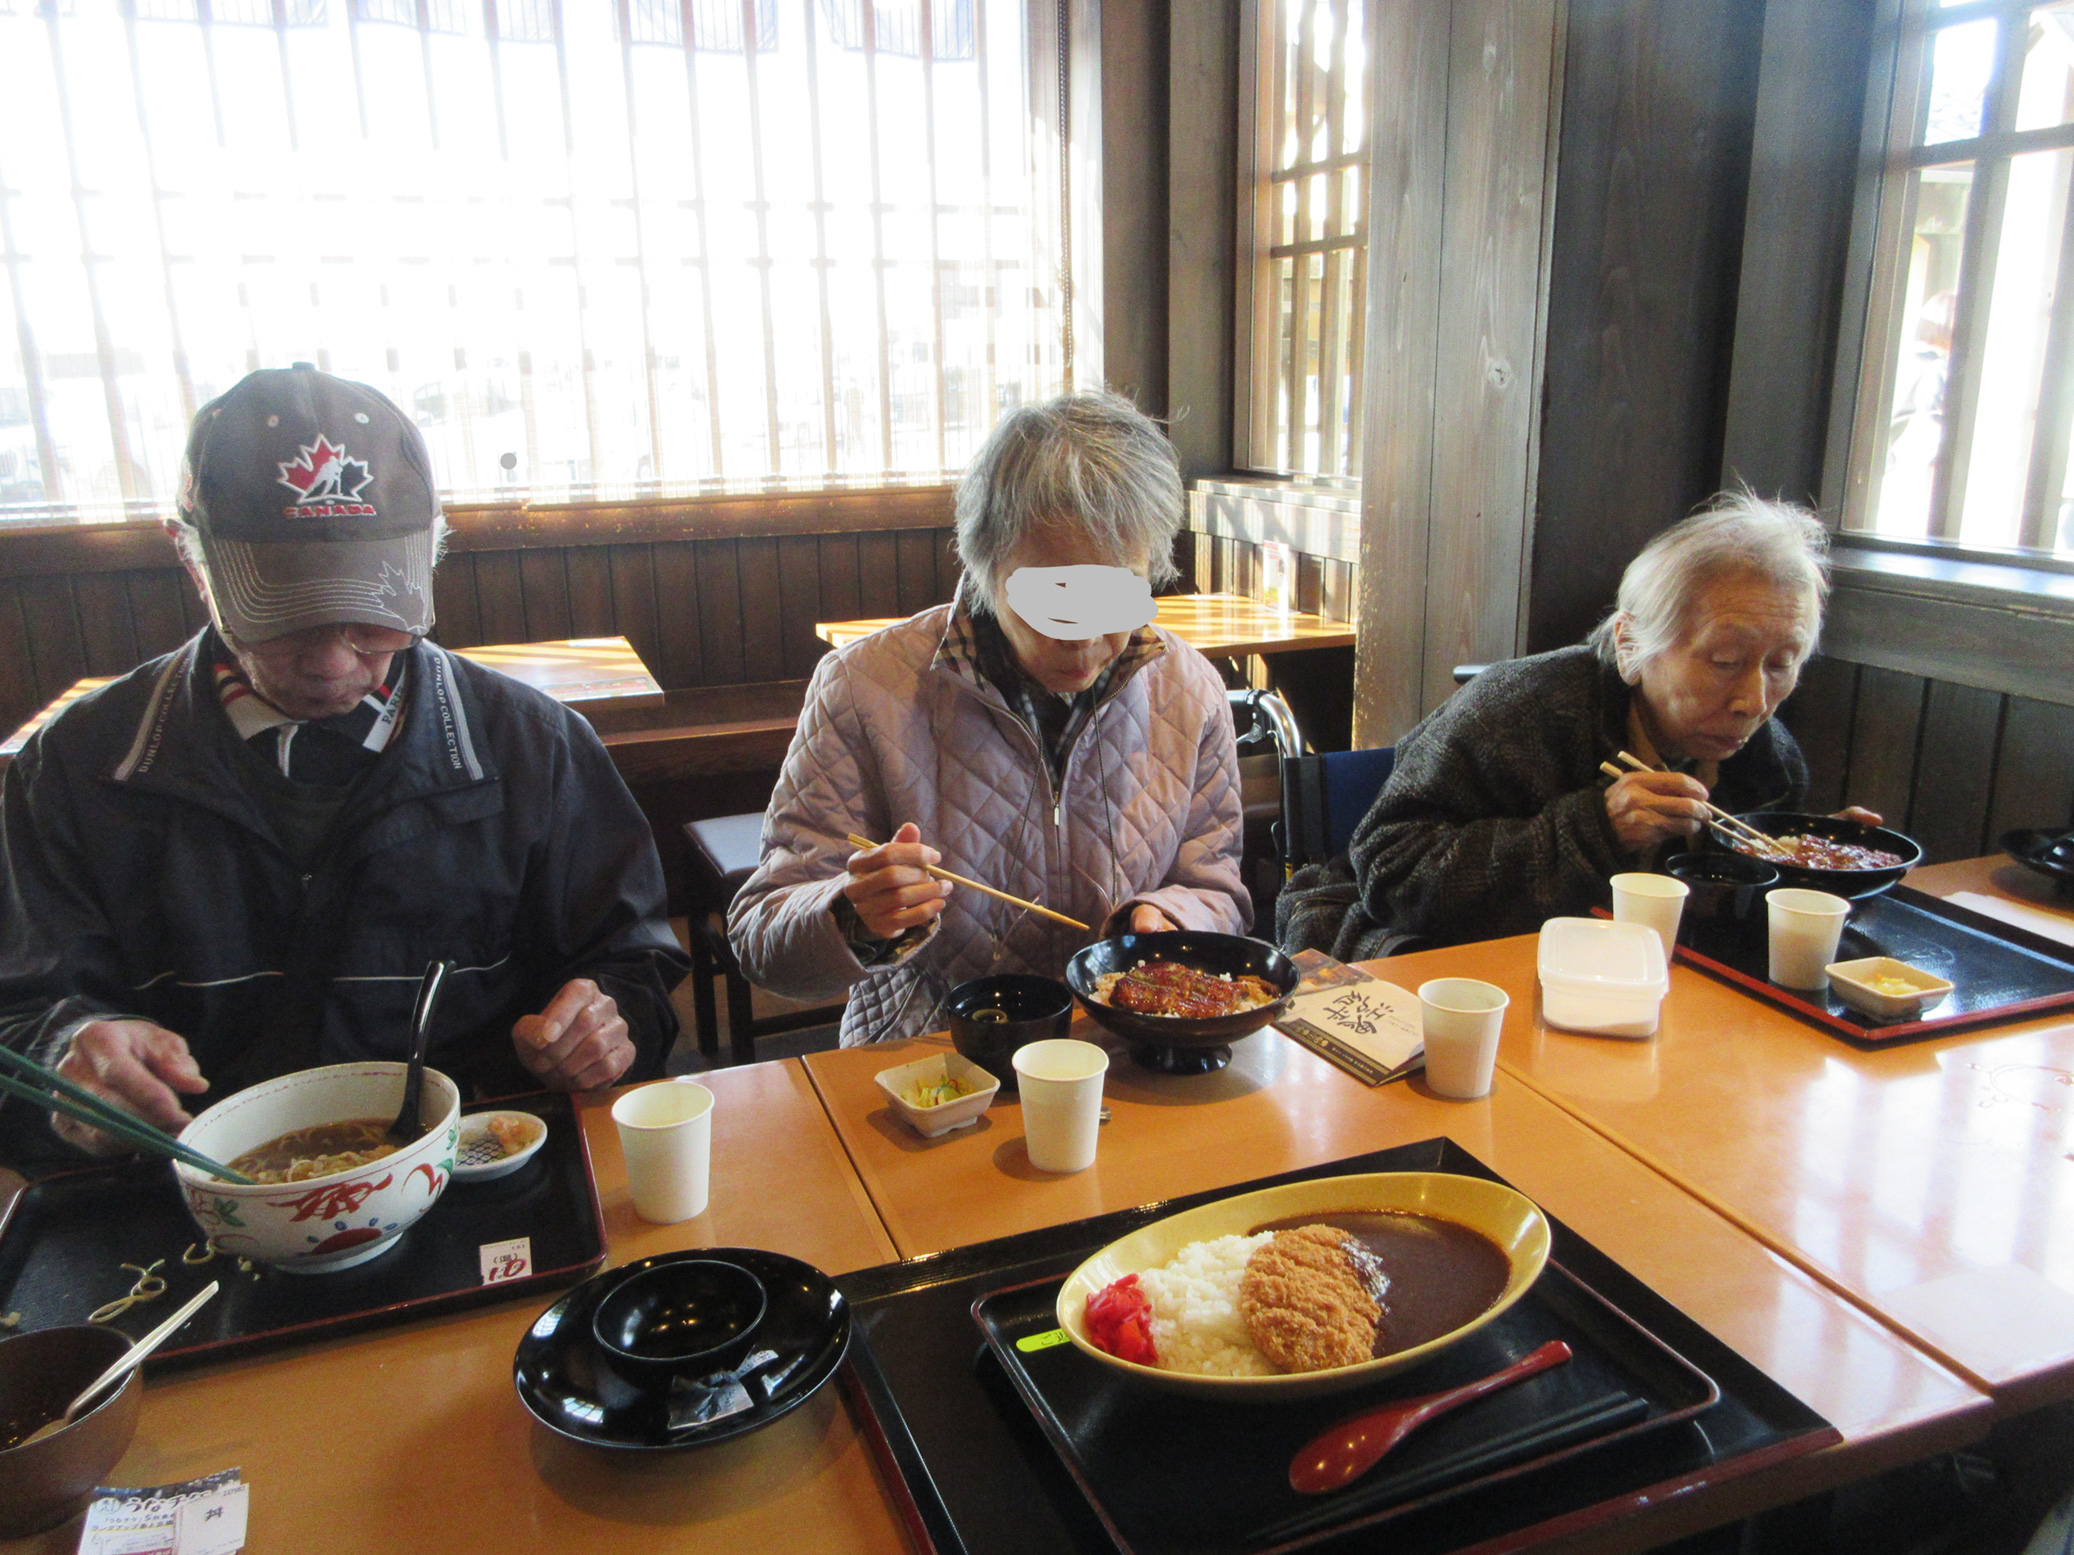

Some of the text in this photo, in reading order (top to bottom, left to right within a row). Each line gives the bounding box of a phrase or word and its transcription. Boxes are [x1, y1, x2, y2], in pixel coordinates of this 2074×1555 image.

[283, 503, 376, 518] CANADA
[433, 656, 462, 770] DUNLOP COLLECTION
[138, 724, 163, 773] DUNLOP
